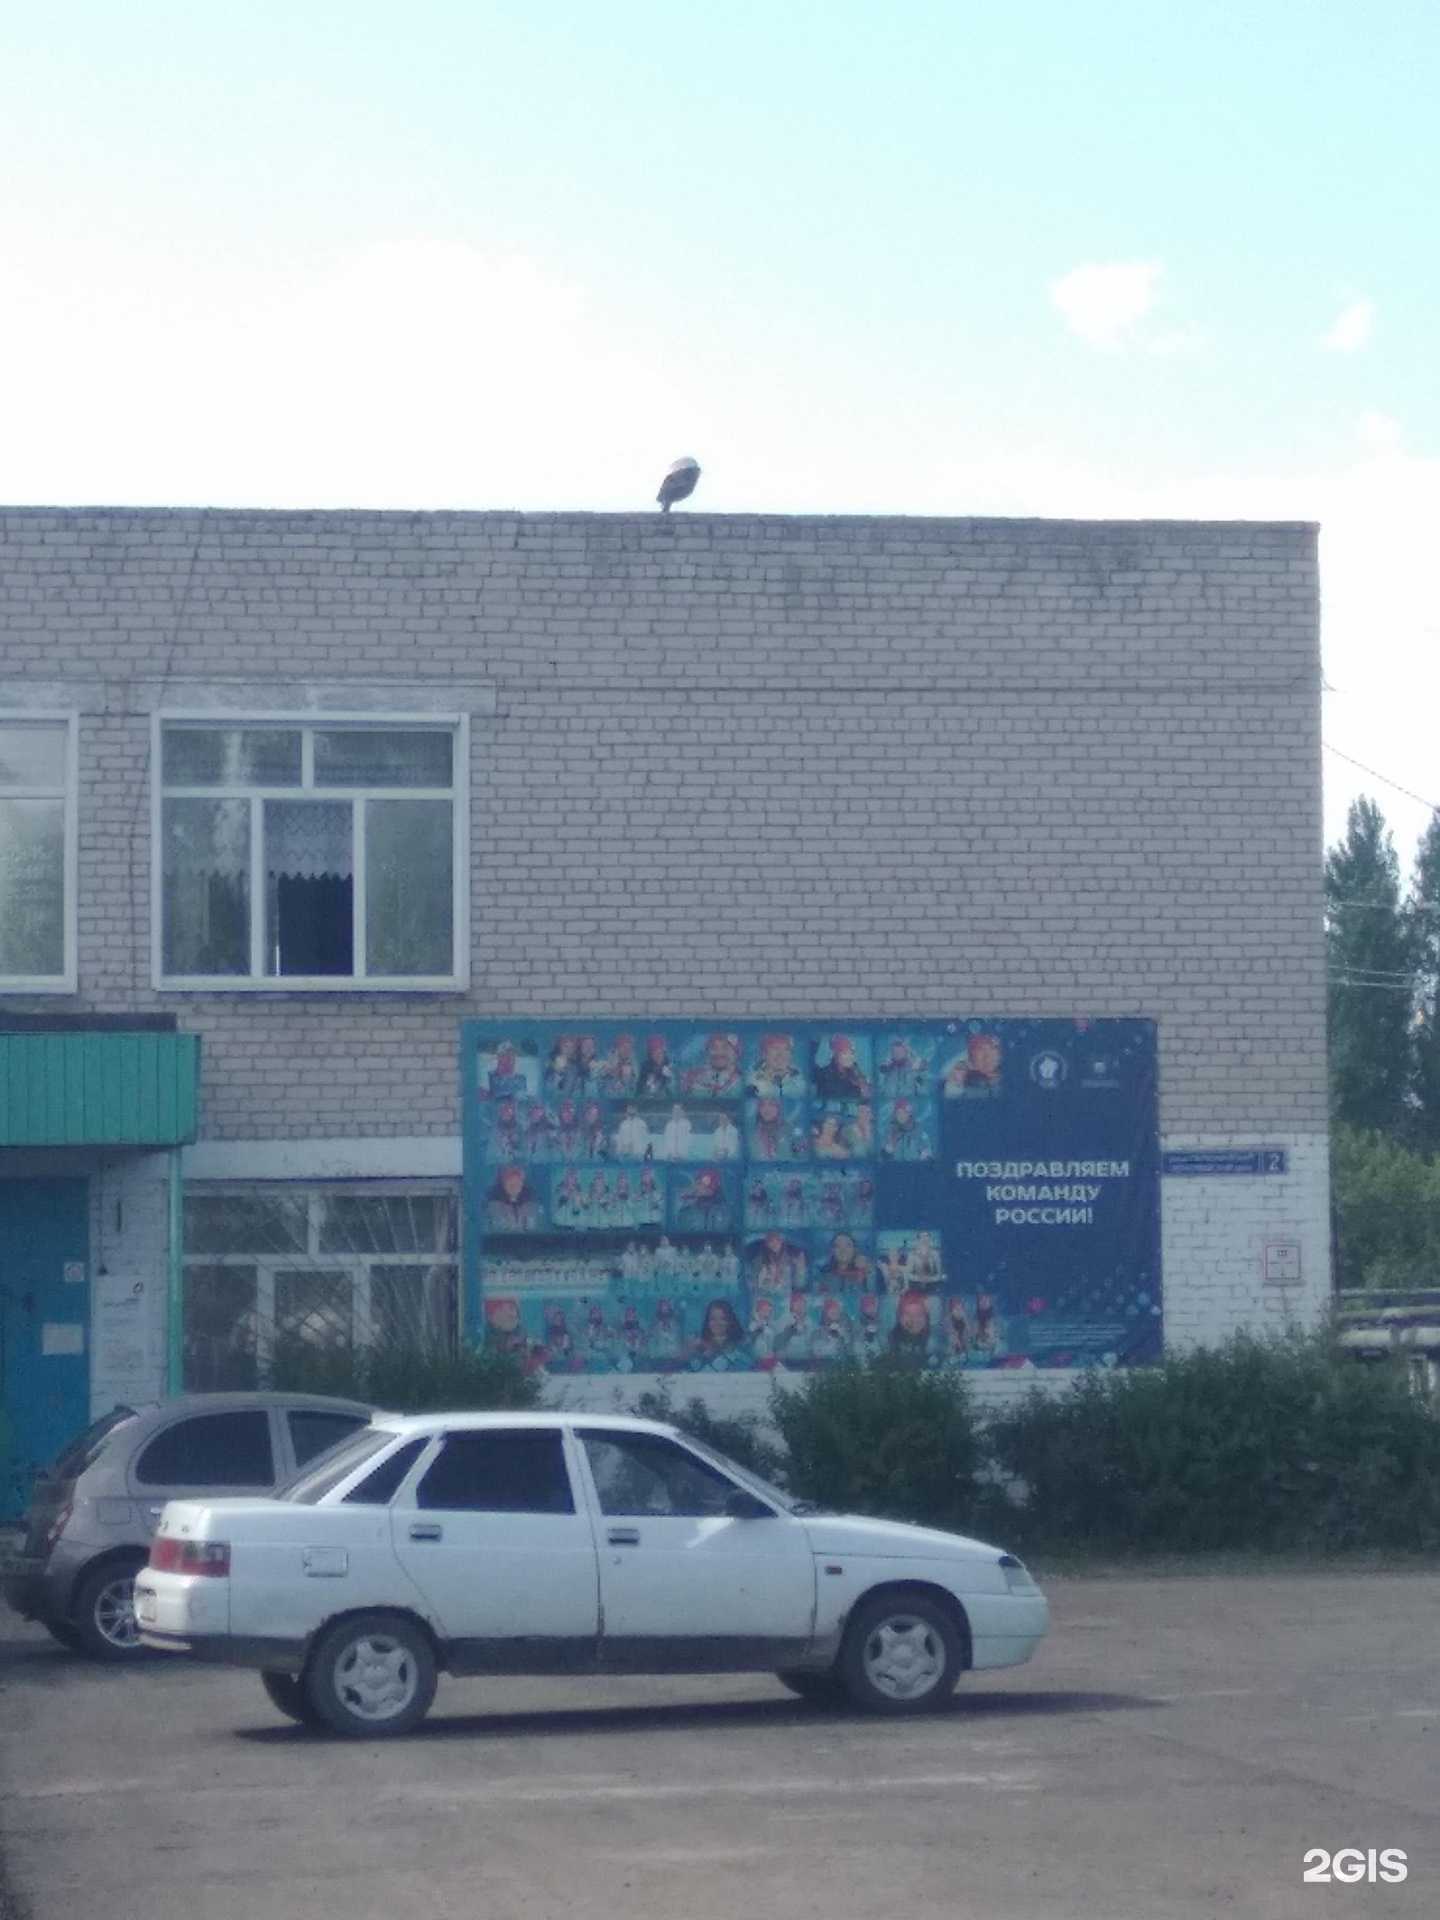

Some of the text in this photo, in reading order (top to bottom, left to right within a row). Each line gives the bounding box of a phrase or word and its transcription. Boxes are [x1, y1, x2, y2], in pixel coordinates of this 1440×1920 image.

[957, 1160, 1130, 1179] ПОЗДРАВЛЯЕМ
[1269, 1153, 1281, 1171] 2
[986, 1184, 1101, 1203] КОМАНДУ
[995, 1207, 1093, 1225] РОССИИ!
